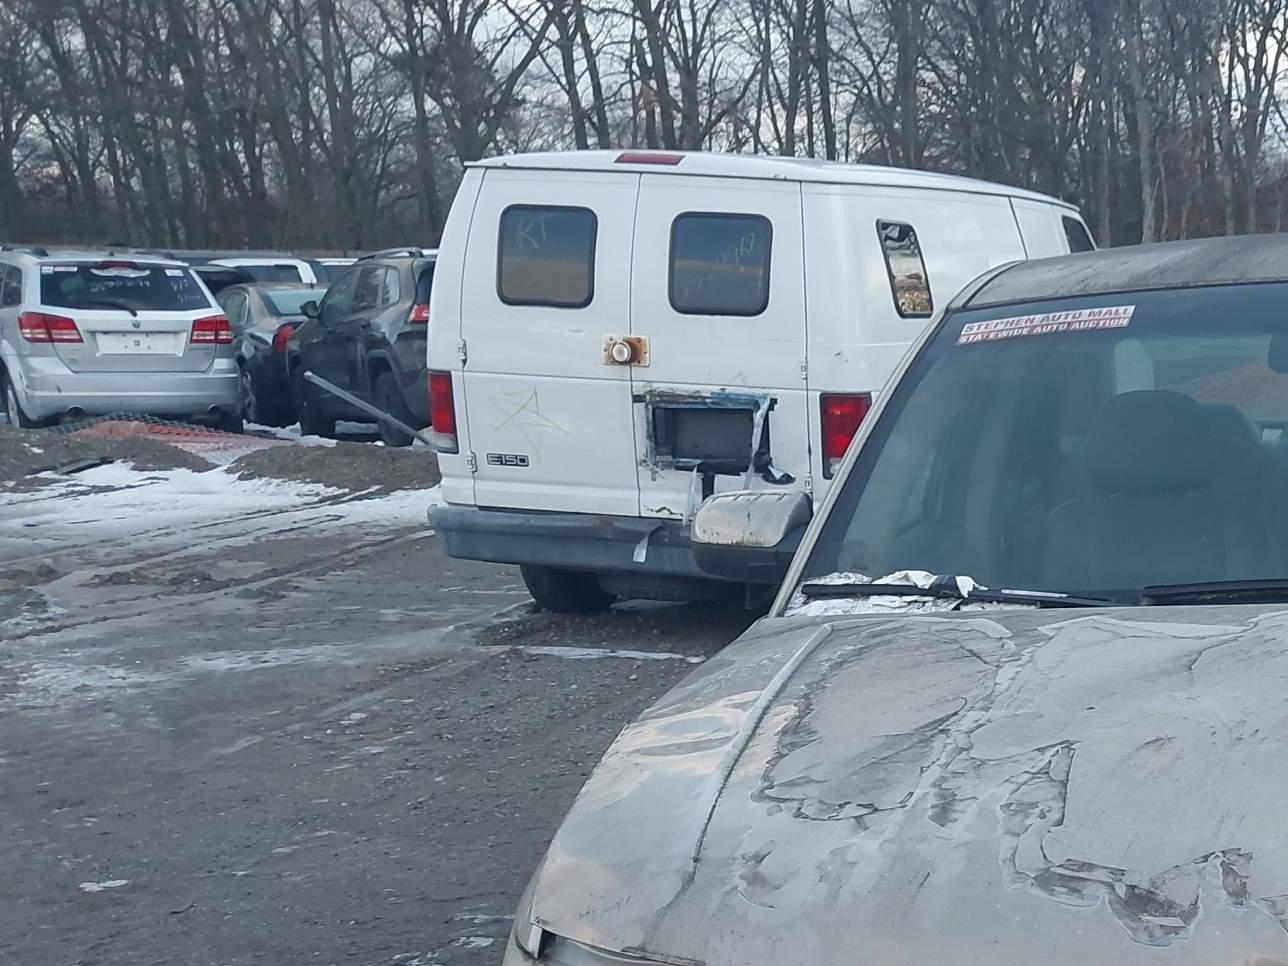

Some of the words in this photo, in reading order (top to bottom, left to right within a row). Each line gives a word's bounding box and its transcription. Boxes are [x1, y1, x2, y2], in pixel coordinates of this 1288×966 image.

[958, 326, 1031, 344] STATEWIDE
[1033, 322, 1068, 334] AUTO
[1070, 317, 1130, 331] AUCTION
[964, 316, 1036, 334] STEPHEN
[1039, 312, 1083, 324] AUTO
[1087, 307, 1132, 319] MALL
[488, 454, 528, 466] E150
